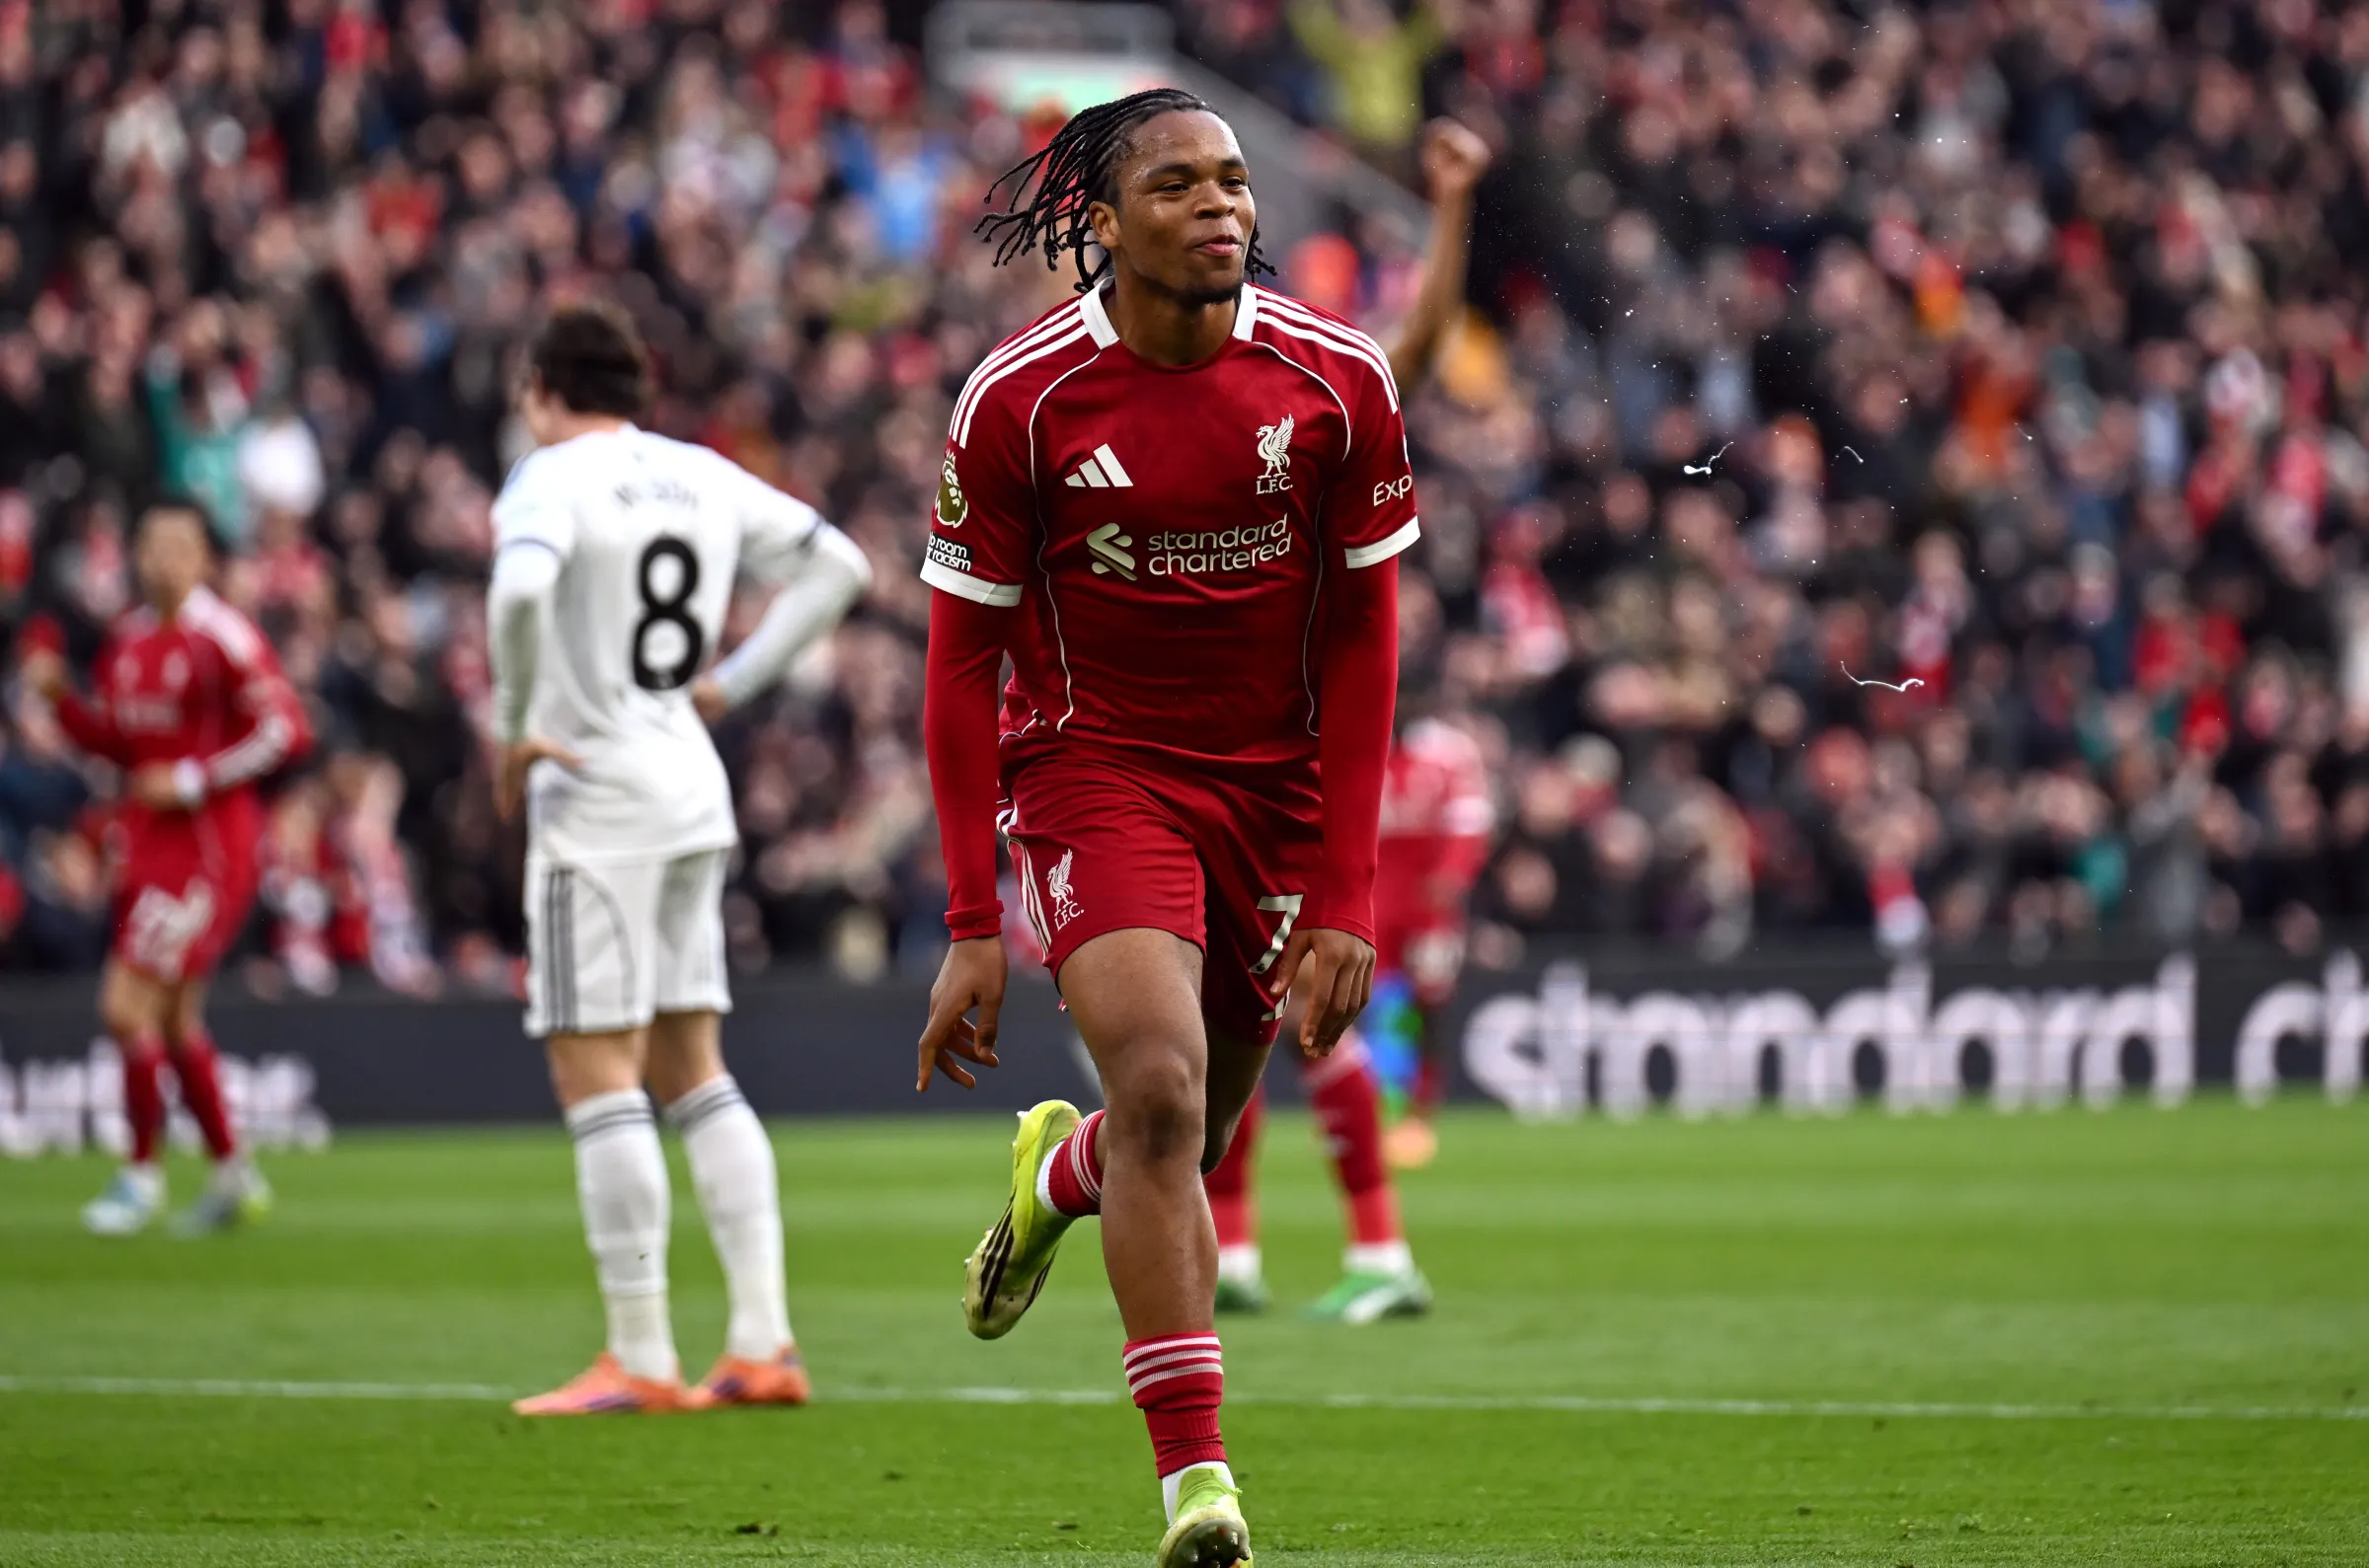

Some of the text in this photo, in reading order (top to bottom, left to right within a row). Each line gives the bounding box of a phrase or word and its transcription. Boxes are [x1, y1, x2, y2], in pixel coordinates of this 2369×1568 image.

[1256, 476, 1293, 495] L.F.C.
[1373, 474, 1413, 506] Exp
[1148, 512, 1288, 551] standard
[932, 550, 971, 571] racism
[936, 538, 967, 559] room
[1148, 532, 1292, 575] chartered
[633, 534, 703, 691] 8
